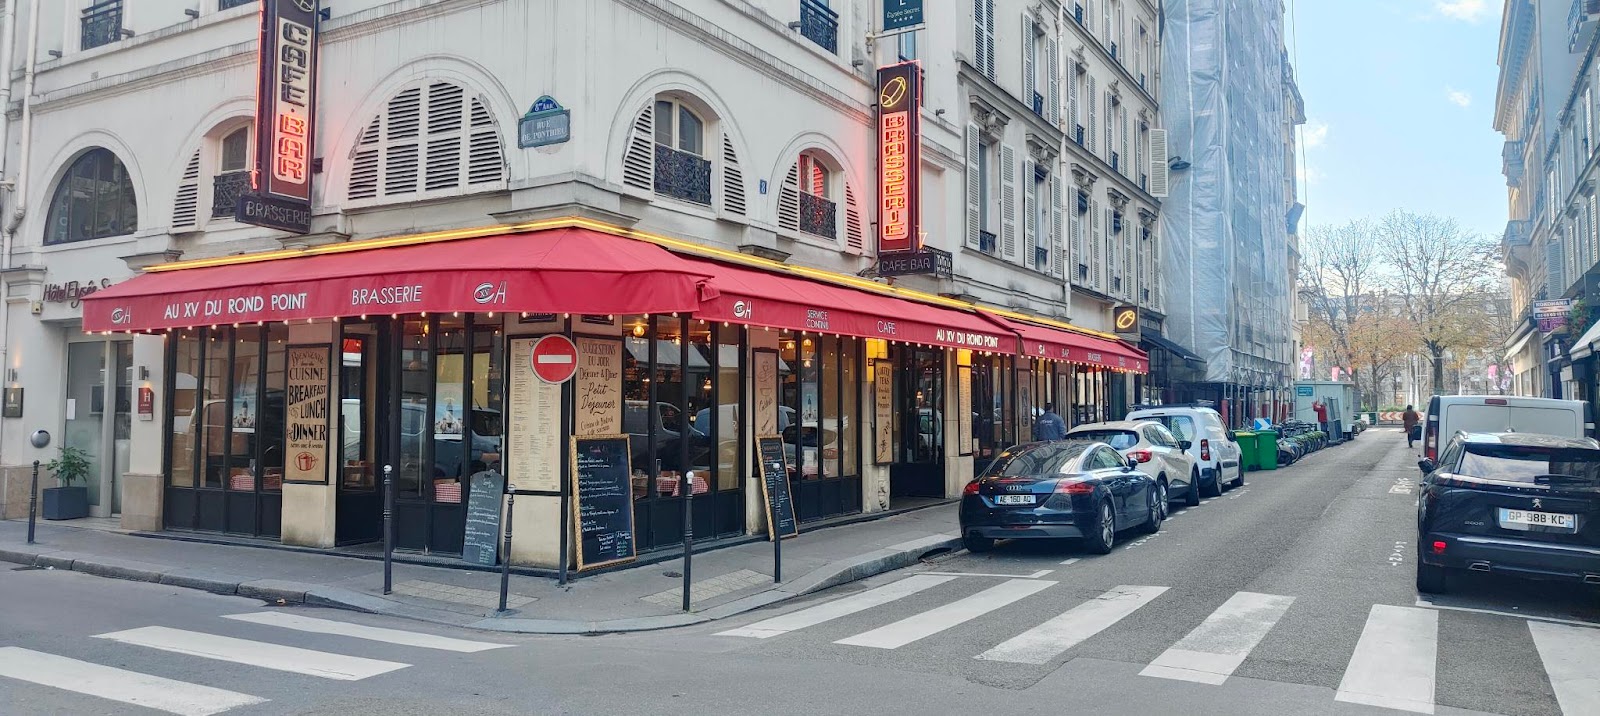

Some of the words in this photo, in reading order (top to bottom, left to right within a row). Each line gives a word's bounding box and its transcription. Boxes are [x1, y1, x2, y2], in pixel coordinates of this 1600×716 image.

[278, 113, 305, 180] BAR
[884, 115, 905, 237] BRASSERIE
[246, 201, 310, 226] BRASSERIE
[910, 257, 931, 270] BAR
[164, 304, 179, 319] AU
[184, 301, 200, 318] XV
[205, 299, 222, 316] DU
[228, 296, 264, 314] ROND
[271, 292, 308, 311] POINT
[352, 285, 423, 306] BRASSERIE
[807, 309, 828, 321] SERVICE
[936, 328, 945, 341] AU
[946, 330, 955, 342] XV
[956, 332, 966, 345] DU
[967, 333, 983, 346] ROND
[984, 335, 999, 348] POINT
[289, 367, 327, 381] CUISINE
[289, 384, 327, 406] BREAKFAST
[301, 398, 326, 419] LUNCH
[291, 422, 326, 442] DINNER
